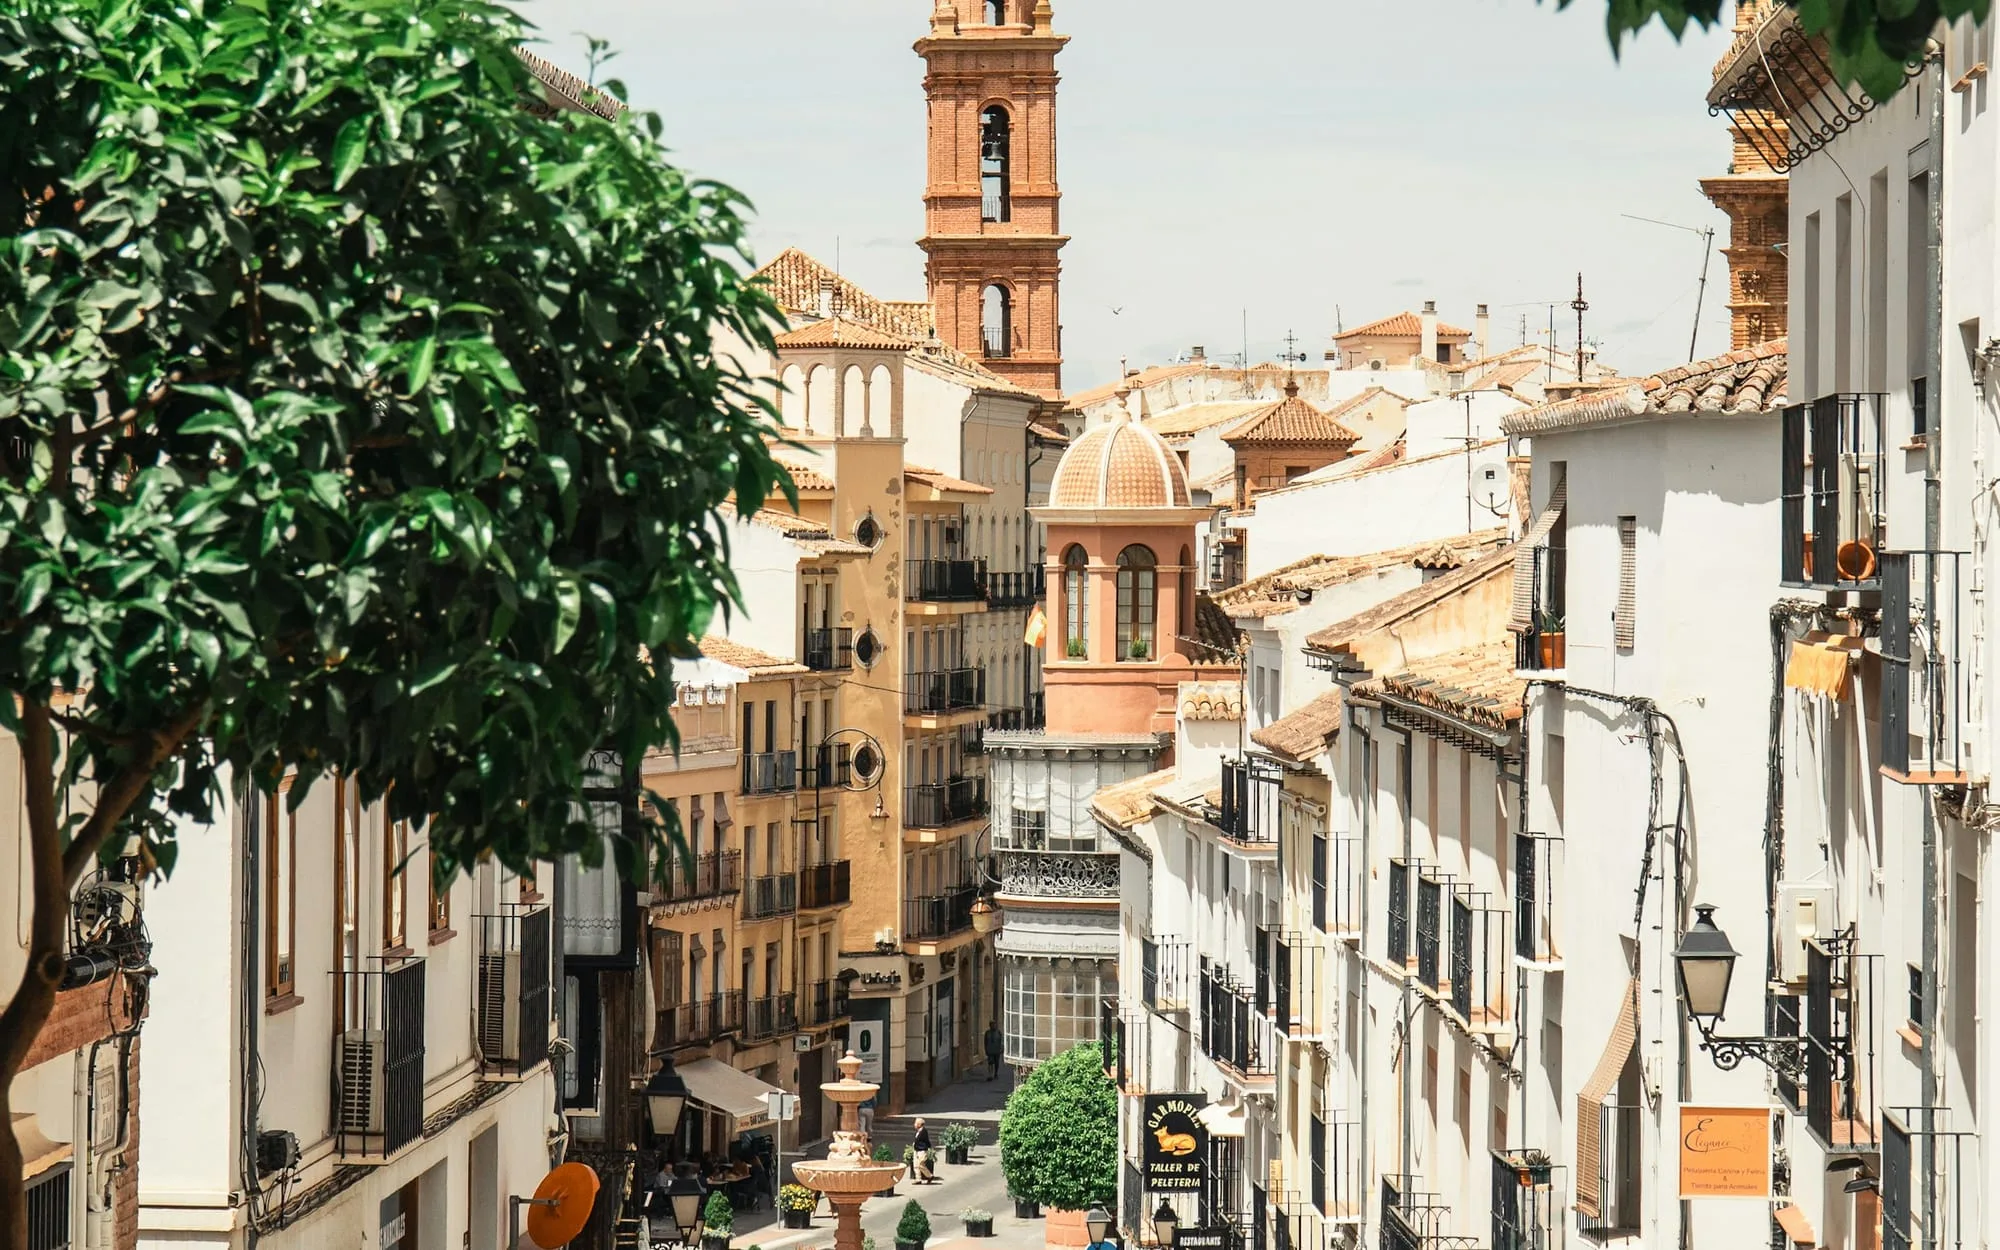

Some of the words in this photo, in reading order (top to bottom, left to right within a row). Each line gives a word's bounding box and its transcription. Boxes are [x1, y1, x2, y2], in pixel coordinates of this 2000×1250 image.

[1150, 1163, 1182, 1172] TALLER
[1187, 1163, 1201, 1172] DE
[1151, 1177, 1201, 1187] PELETERIA
